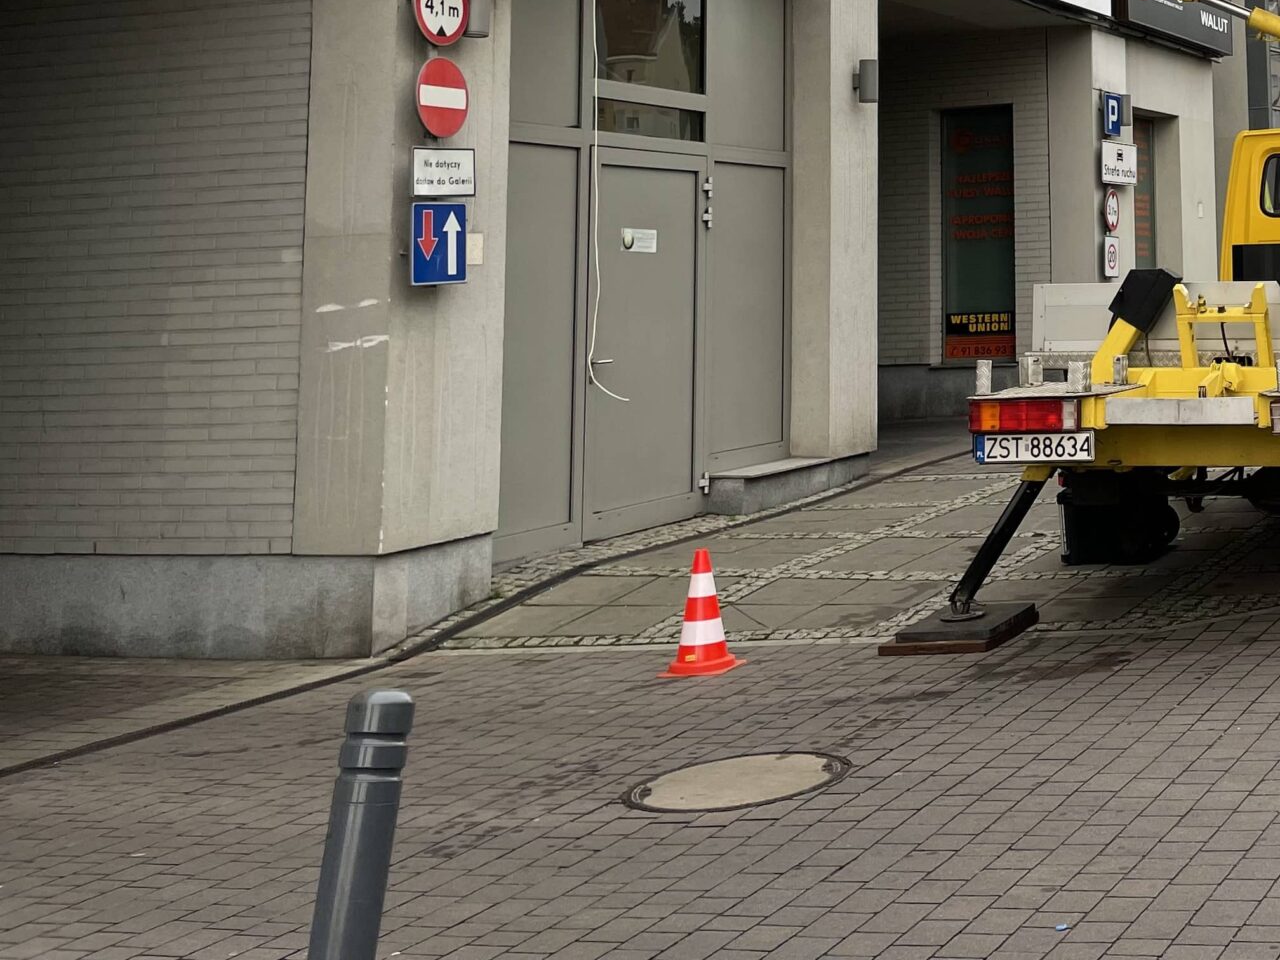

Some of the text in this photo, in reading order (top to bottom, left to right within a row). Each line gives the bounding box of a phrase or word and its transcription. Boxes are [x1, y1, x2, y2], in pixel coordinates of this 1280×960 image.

[1200, 9, 1229, 33] WALUT
[1108, 99, 1118, 129] P
[1104, 164, 1136, 179] Strefa ruchu
[950, 313, 1008, 324] WESTERN
[968, 322, 1008, 333] UNION
[986, 436, 1091, 459] ZST 88634
